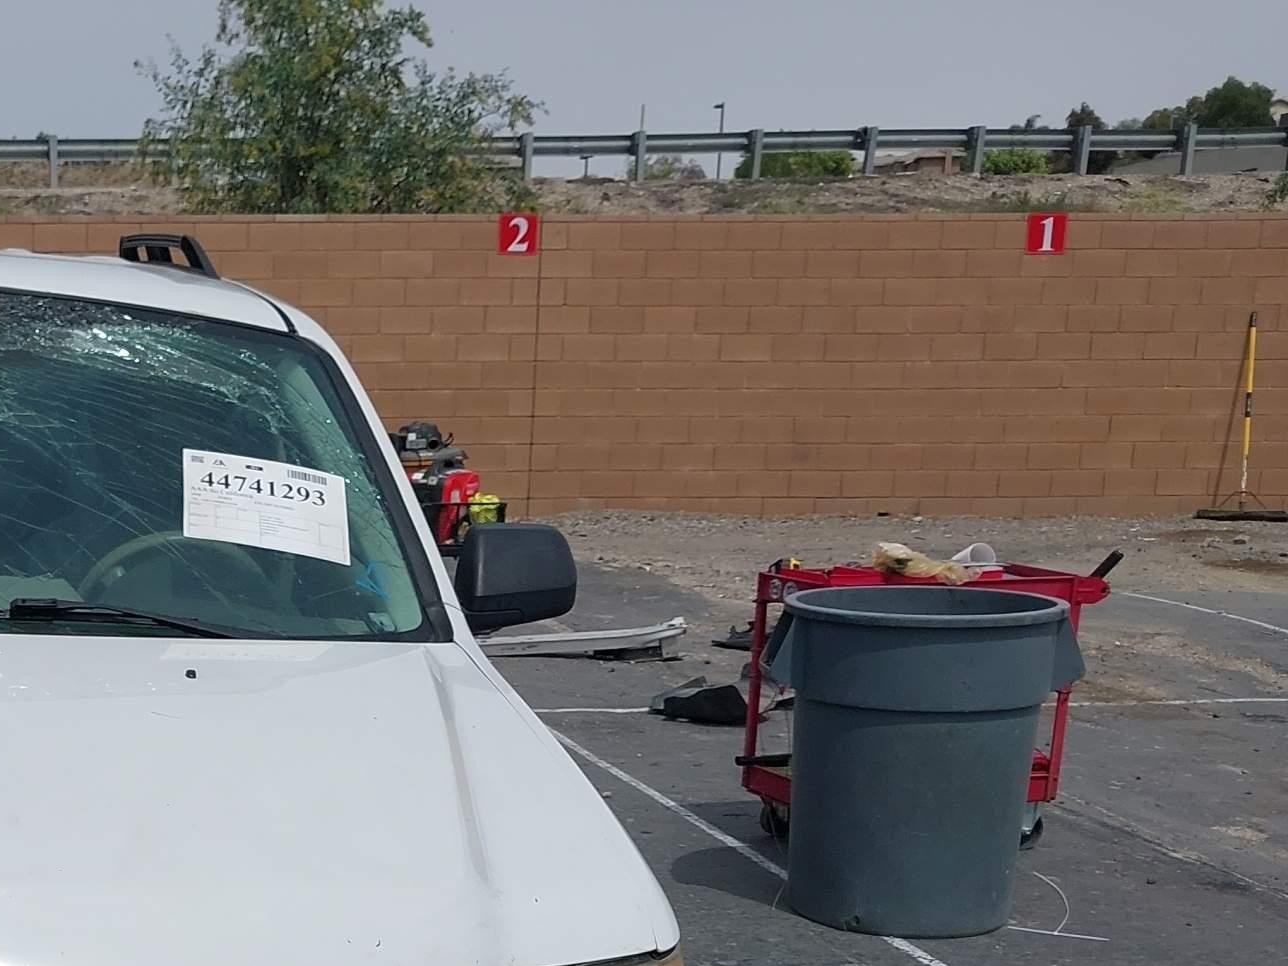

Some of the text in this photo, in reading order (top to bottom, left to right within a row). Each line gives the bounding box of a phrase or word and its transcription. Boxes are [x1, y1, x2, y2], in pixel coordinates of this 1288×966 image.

[506, 216, 530, 252] 2
[1036, 216, 1055, 252] 1
[199, 471, 327, 507] 44741293
